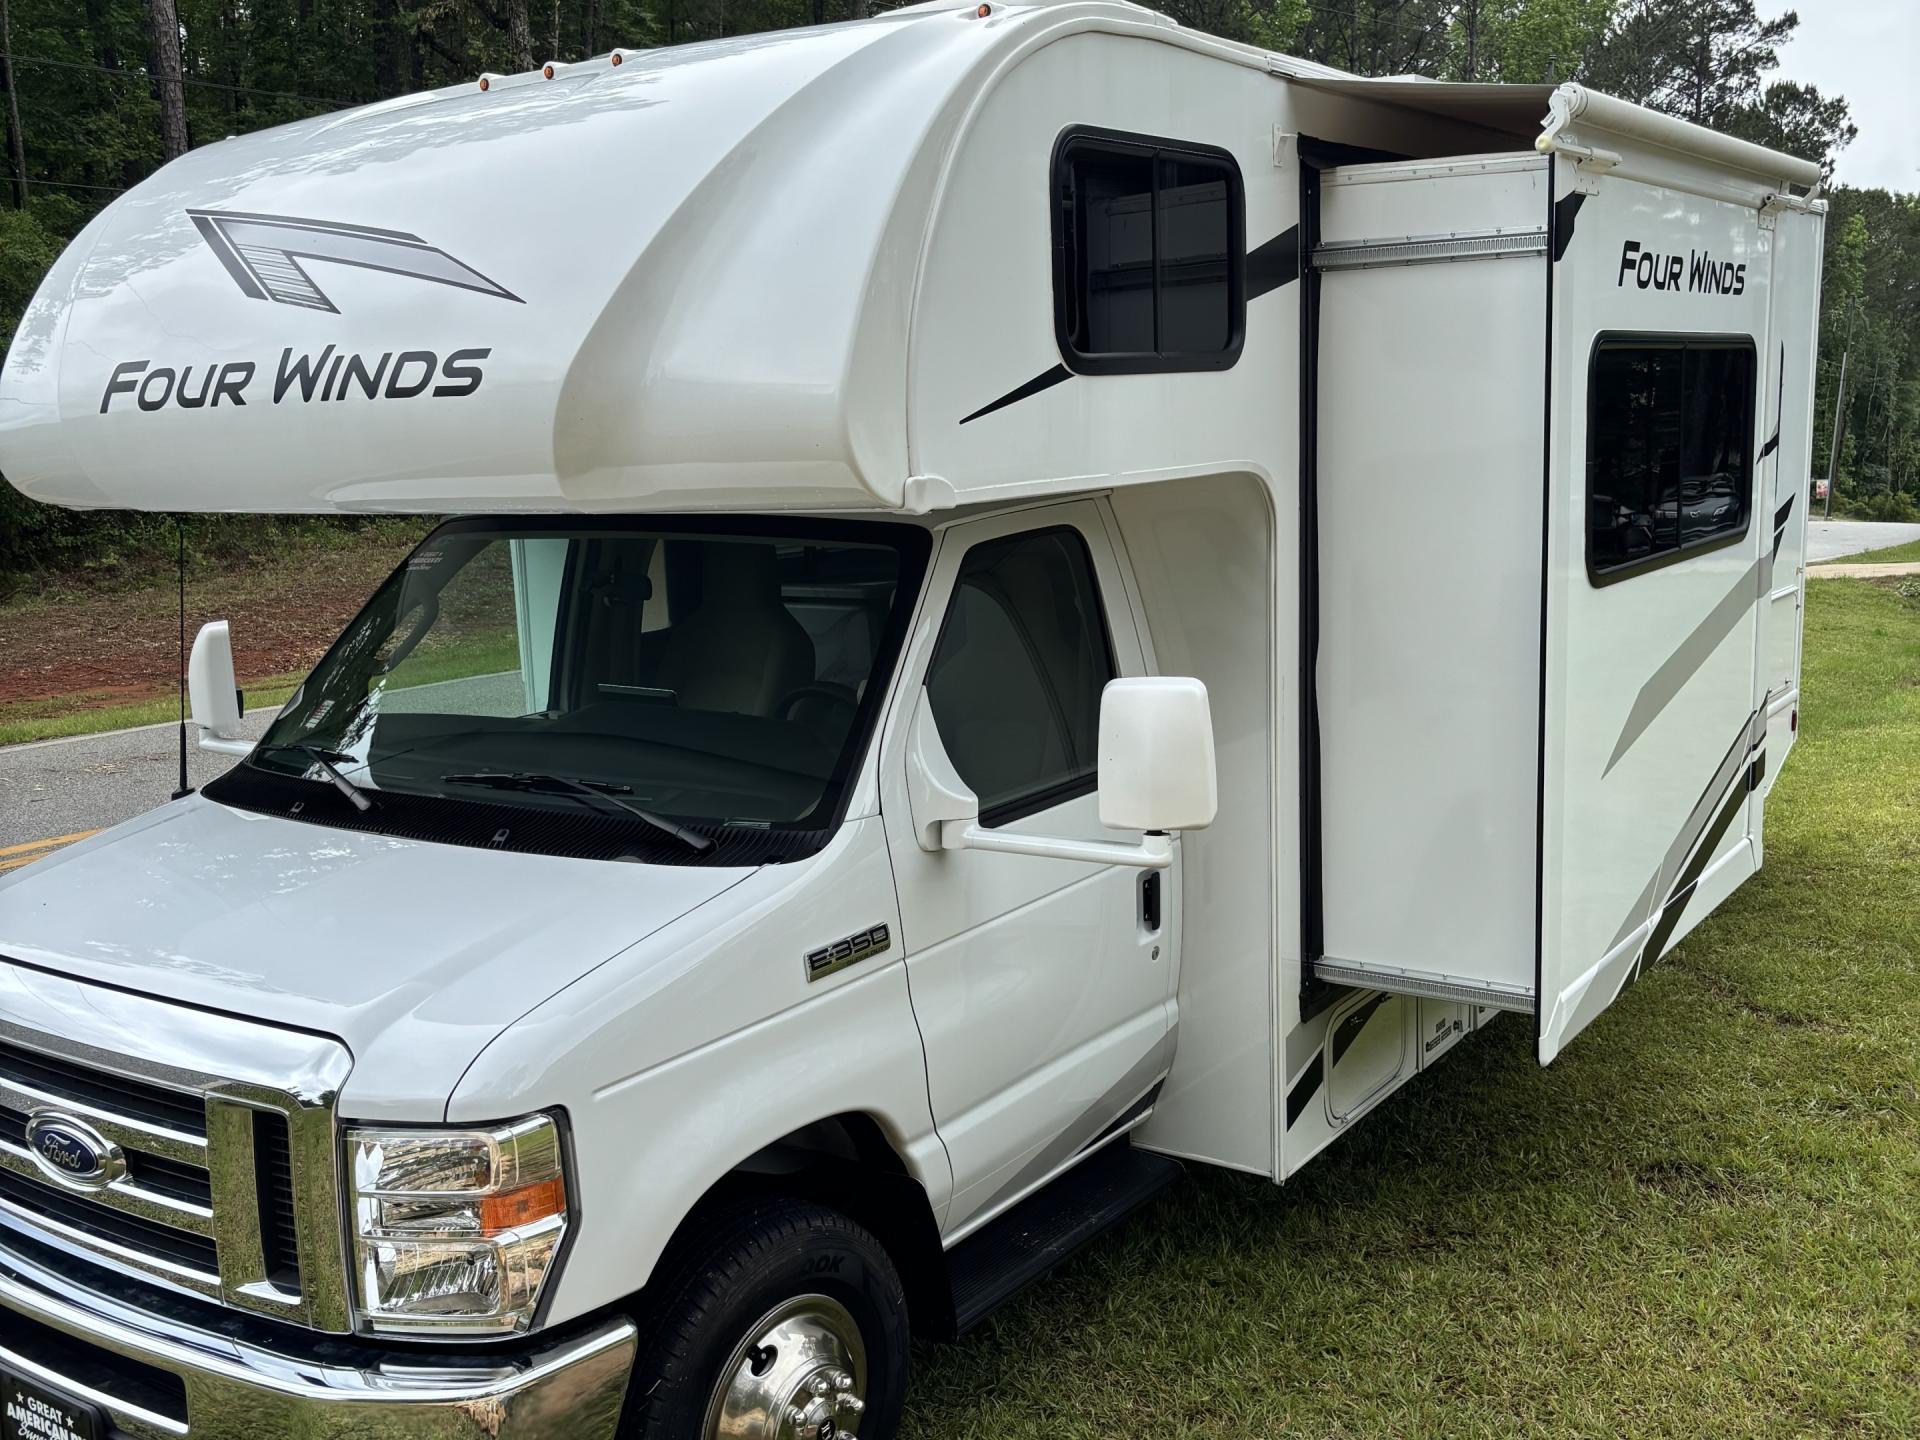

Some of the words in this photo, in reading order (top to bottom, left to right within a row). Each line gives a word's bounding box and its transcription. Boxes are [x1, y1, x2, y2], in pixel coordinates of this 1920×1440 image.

[1618, 240, 1684, 292] FOUR
[1689, 249, 1746, 296] WINDS
[99, 359, 256, 414] FOUR
[273, 344, 492, 405] WINDS
[807, 923, 889, 971] E-350
[42, 1133, 81, 1168] Ford
[7, 1402, 69, 1440] AMERICAN
[27, 1396, 62, 1424] GREAT
